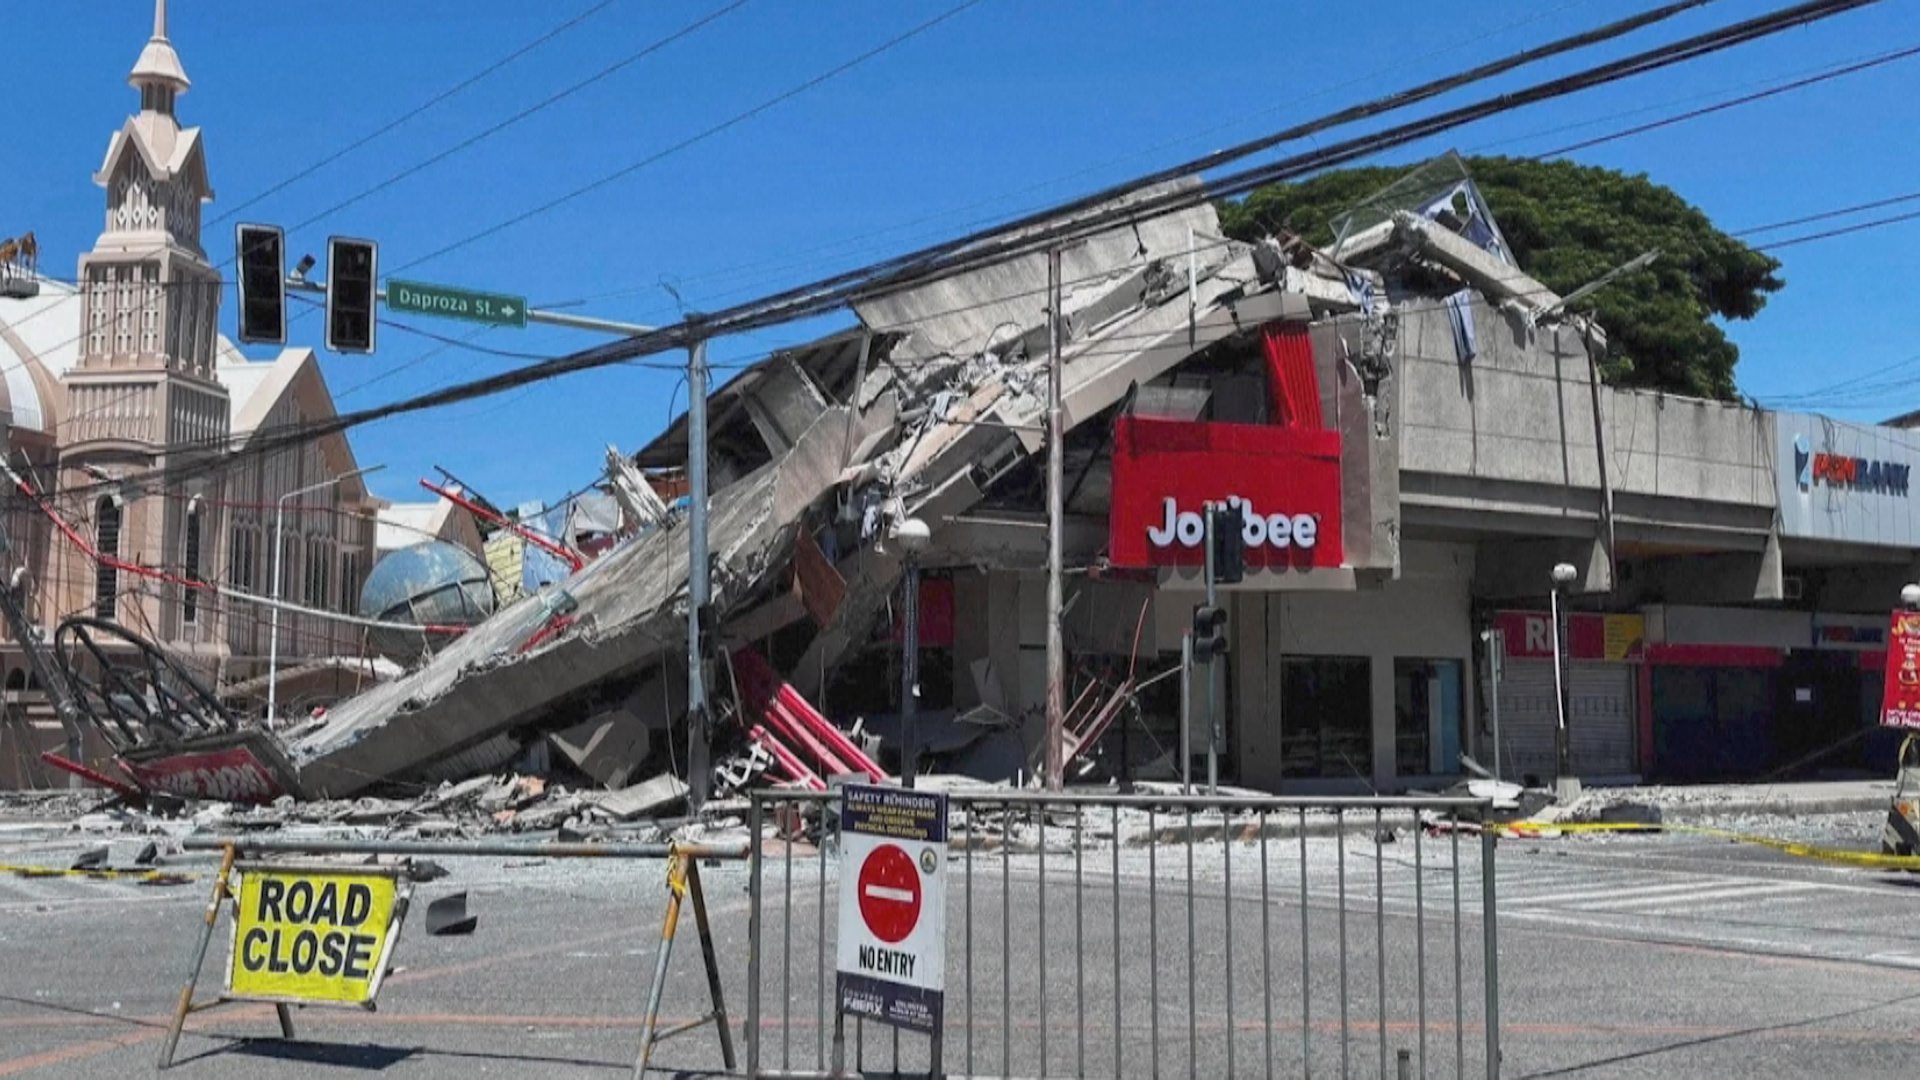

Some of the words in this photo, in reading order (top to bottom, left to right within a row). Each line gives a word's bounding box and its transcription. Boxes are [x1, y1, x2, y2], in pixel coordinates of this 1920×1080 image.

[399, 288, 468, 312] Daproza
[475, 301, 495, 317] St.
[1147, 495, 1317, 548] Jobee
[848, 792, 881, 803] SAFETY
[883, 795, 936, 809] REMINDERS
[258, 880, 371, 926] ROAD
[242, 927, 377, 979] CLOSE
[858, 944, 875, 969] NO
[877, 948, 916, 979] ENTRY
